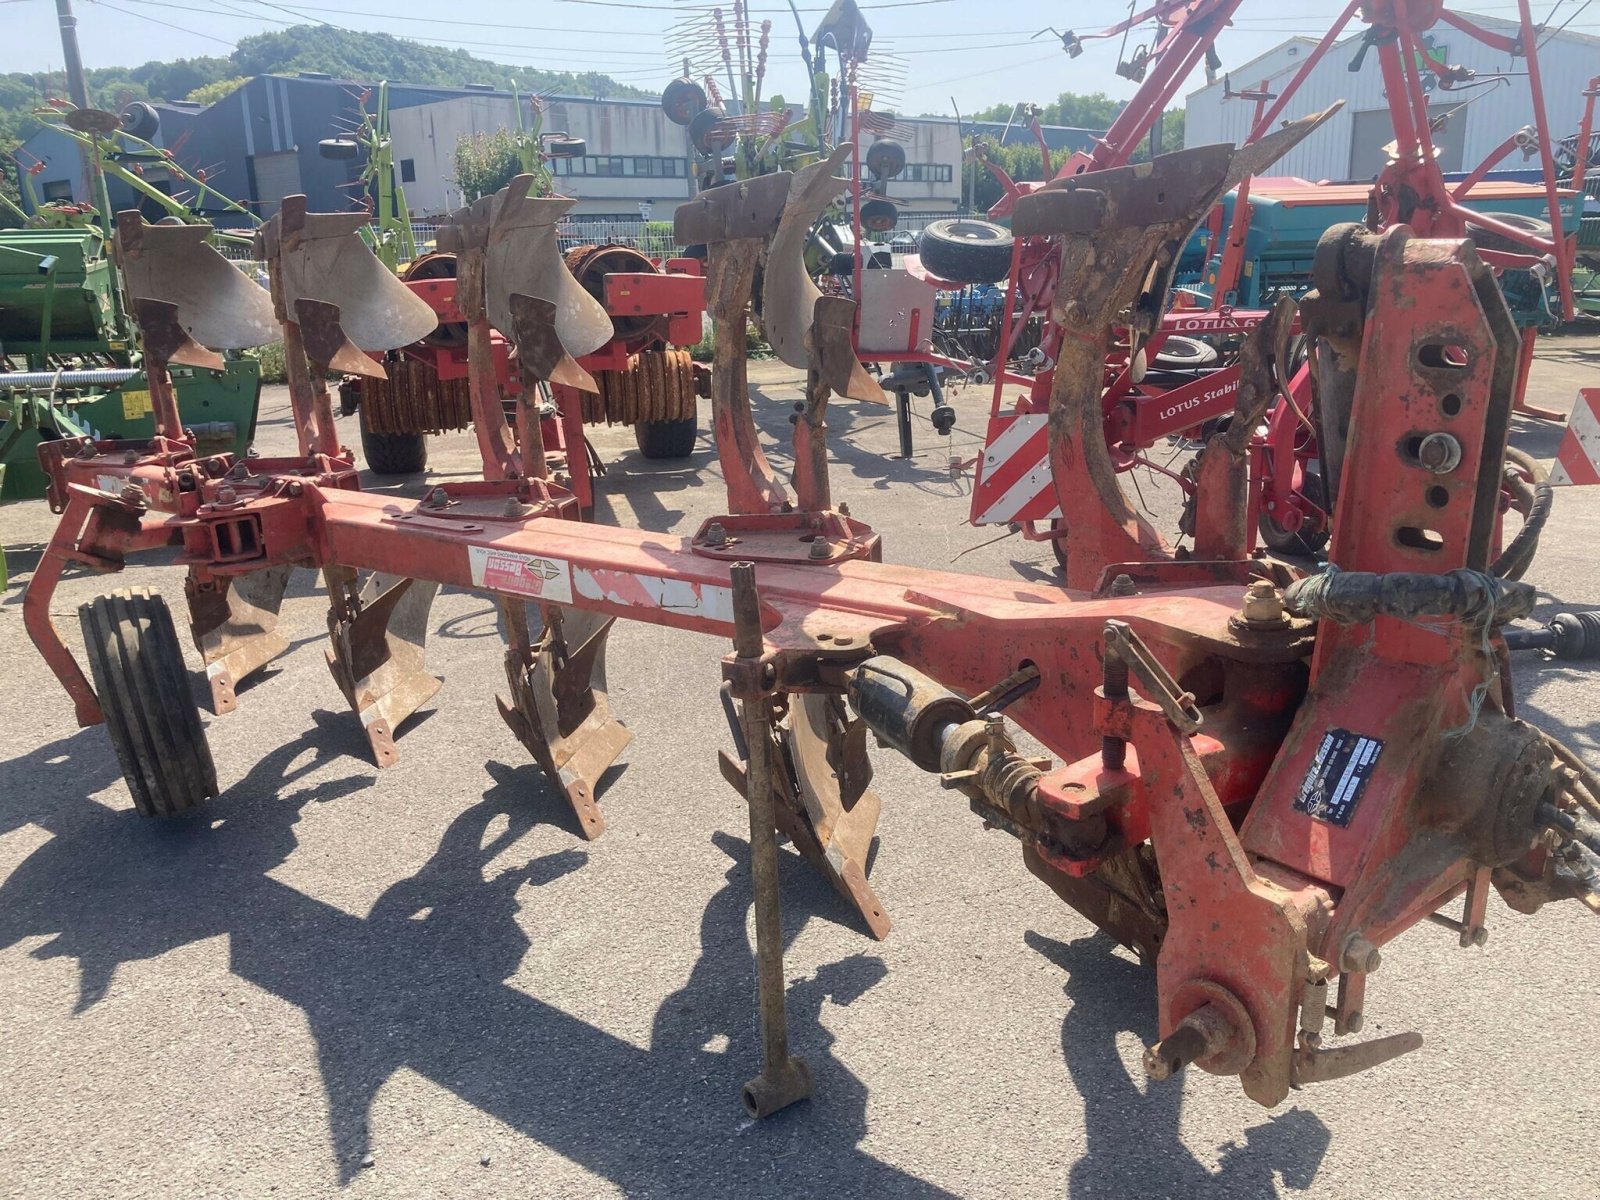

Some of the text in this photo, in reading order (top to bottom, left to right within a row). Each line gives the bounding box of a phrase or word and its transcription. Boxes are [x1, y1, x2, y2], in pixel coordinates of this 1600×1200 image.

[1175, 317, 1236, 331] LOTUS
[1159, 397, 1200, 420] LOTUS
[487, 558, 523, 576] Besson
